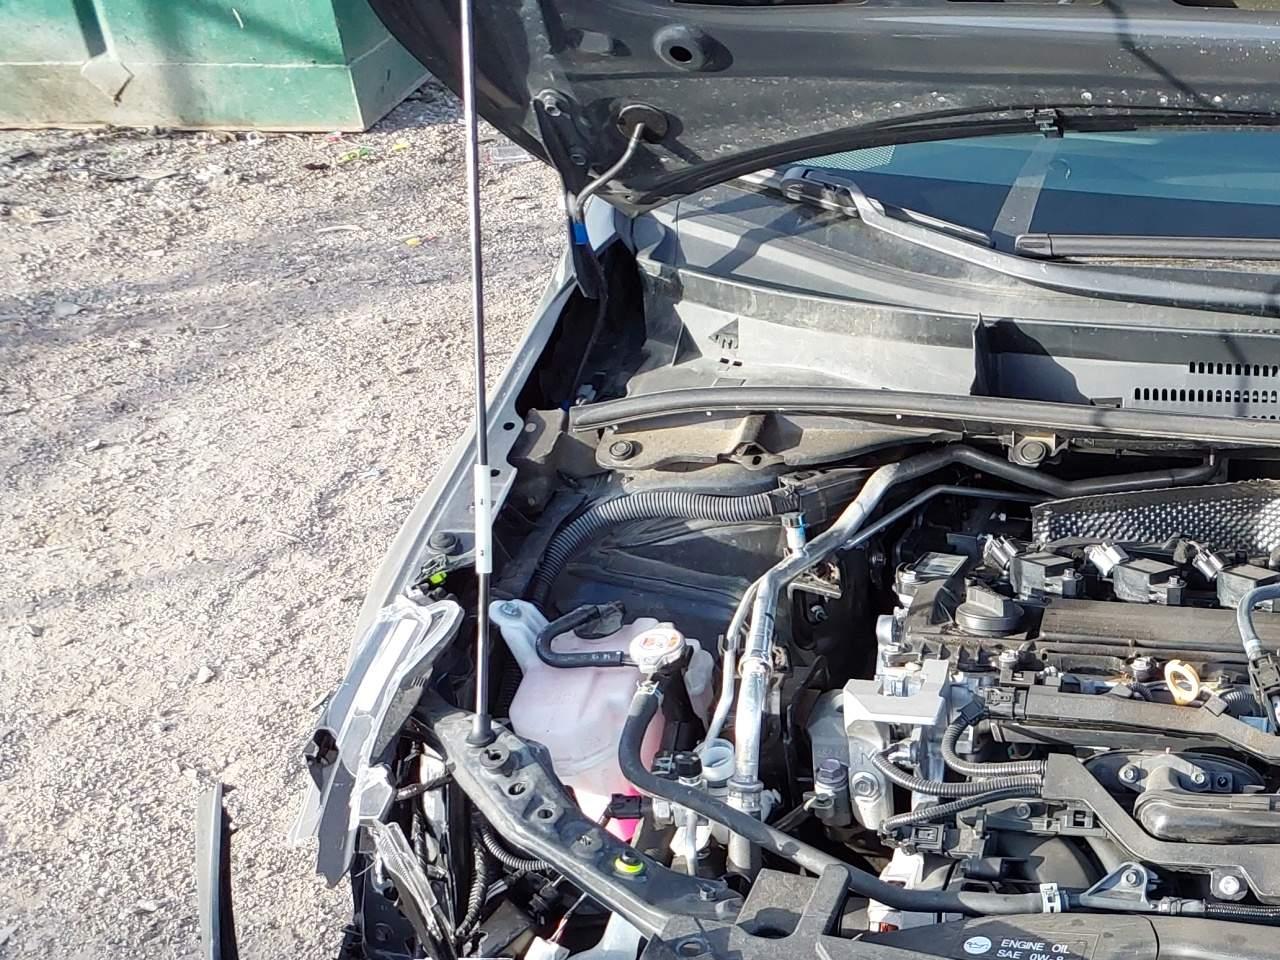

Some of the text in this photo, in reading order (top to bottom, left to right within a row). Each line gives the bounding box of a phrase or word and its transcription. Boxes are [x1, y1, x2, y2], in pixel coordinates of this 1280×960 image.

[1001, 938, 1070, 954] ENGINE OIL
[996, 949, 1023, 959] SAE
